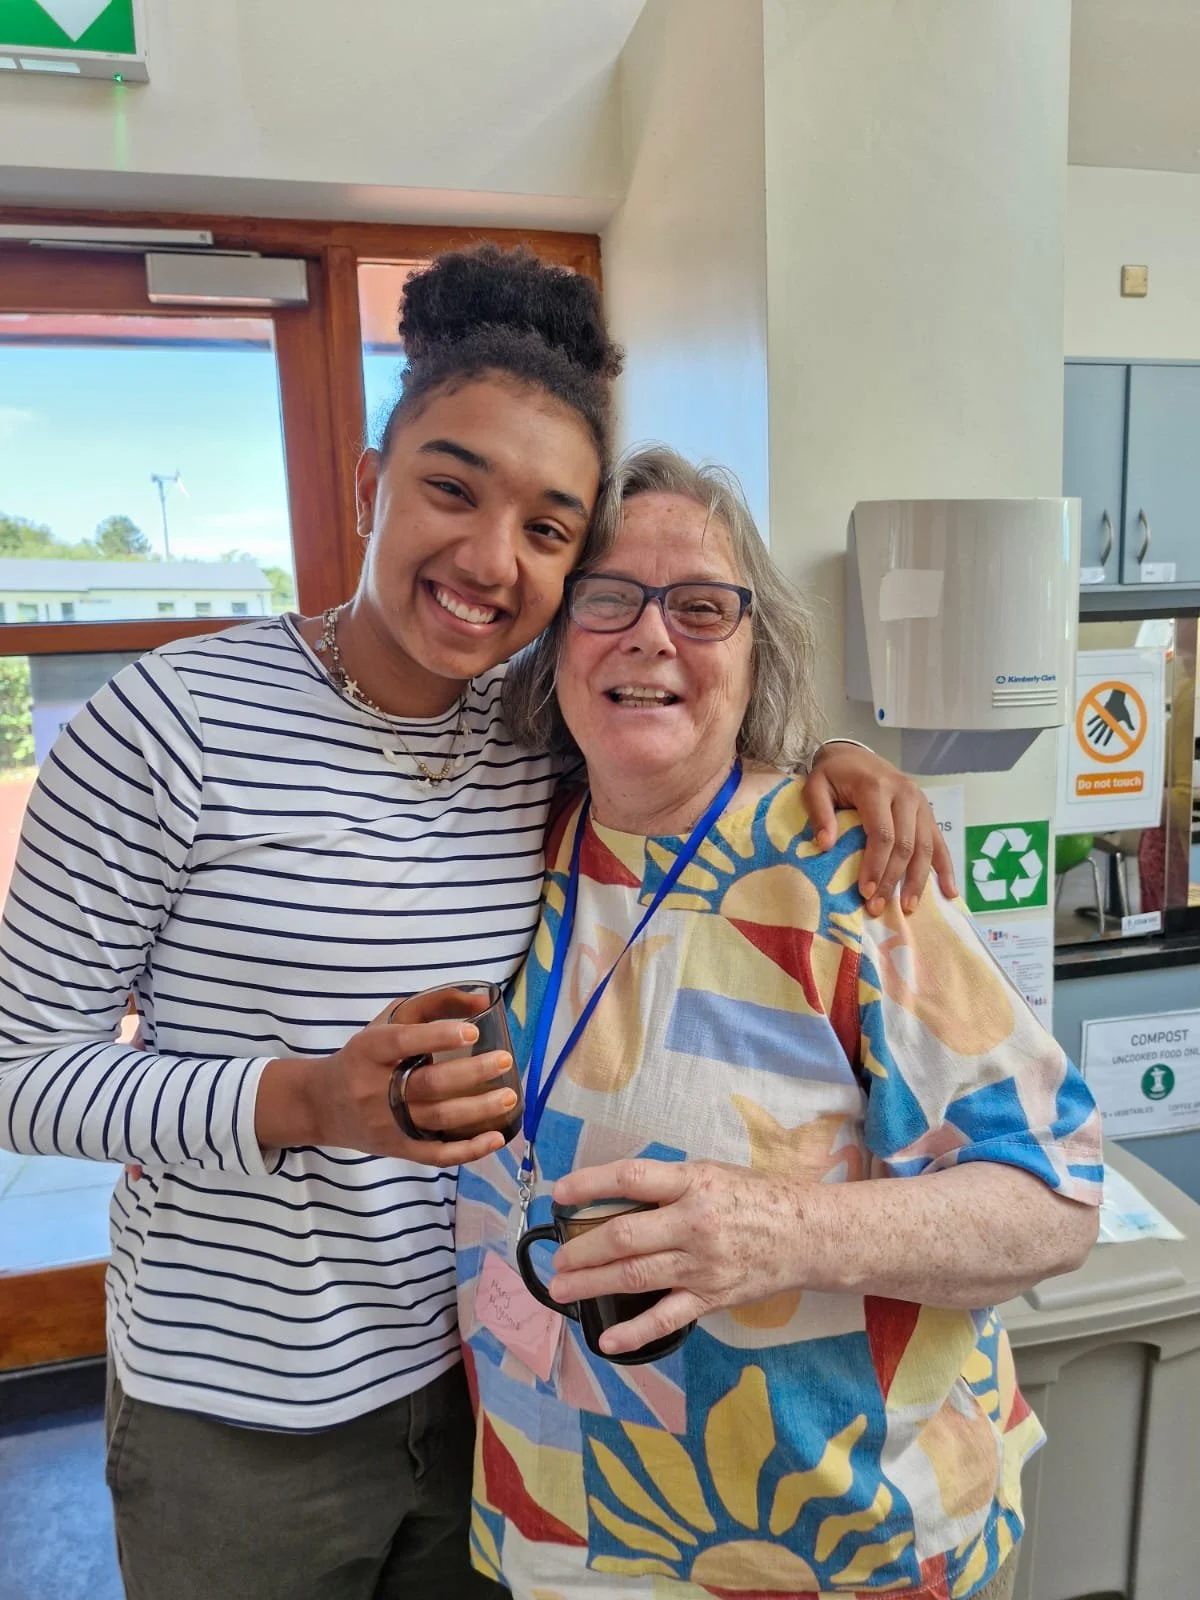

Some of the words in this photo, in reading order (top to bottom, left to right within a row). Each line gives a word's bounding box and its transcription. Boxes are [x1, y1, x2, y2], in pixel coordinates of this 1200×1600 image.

[1077, 779, 1092, 790] Do
[1094, 777, 1112, 789] not
[1113, 775, 1142, 788] touch
[1131, 1029, 1189, 1046] COMPOST
[1112, 1052, 1157, 1064] UNCOOKED
[1159, 1048, 1182, 1060] FOOD
